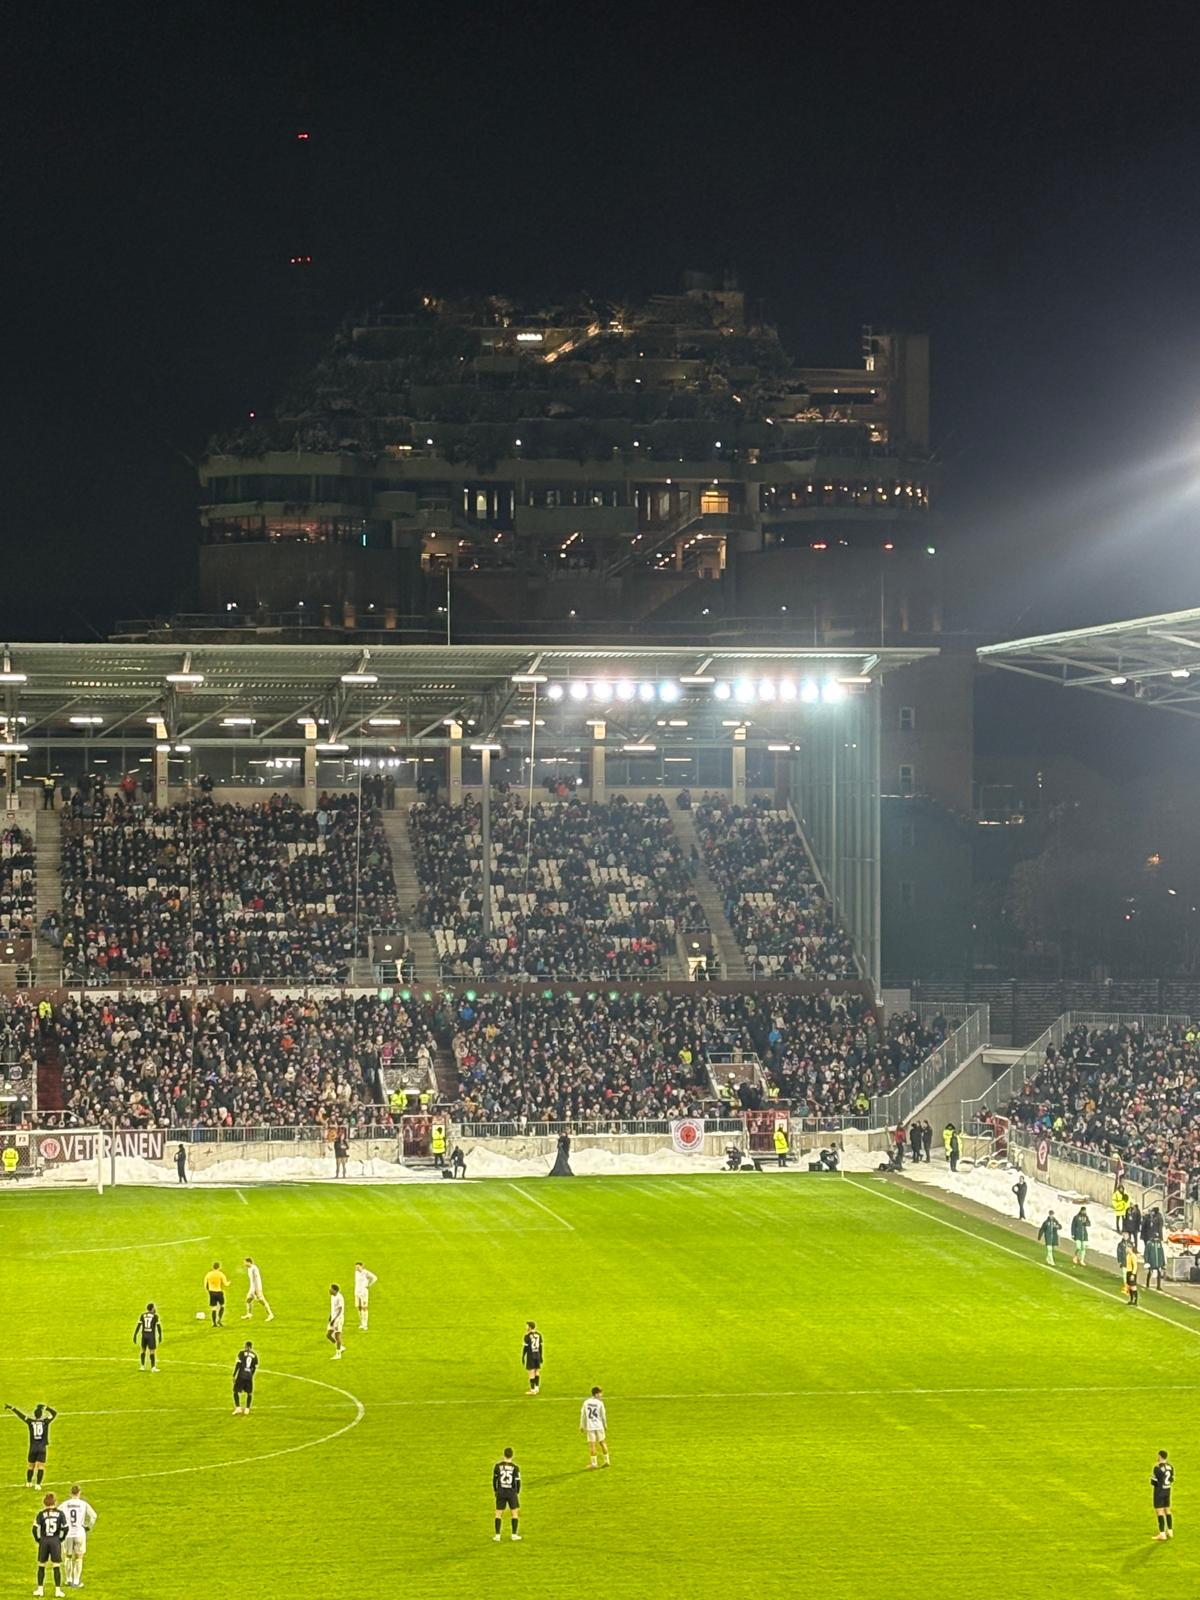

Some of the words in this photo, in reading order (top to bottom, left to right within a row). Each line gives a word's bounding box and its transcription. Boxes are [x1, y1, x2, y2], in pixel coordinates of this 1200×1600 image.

[61, 1133, 161, 1160] VETERANEN
[500, 1470, 513, 1484] 25
[70, 1509, 77, 1524] 9
[45, 1518, 58, 1533] 15
